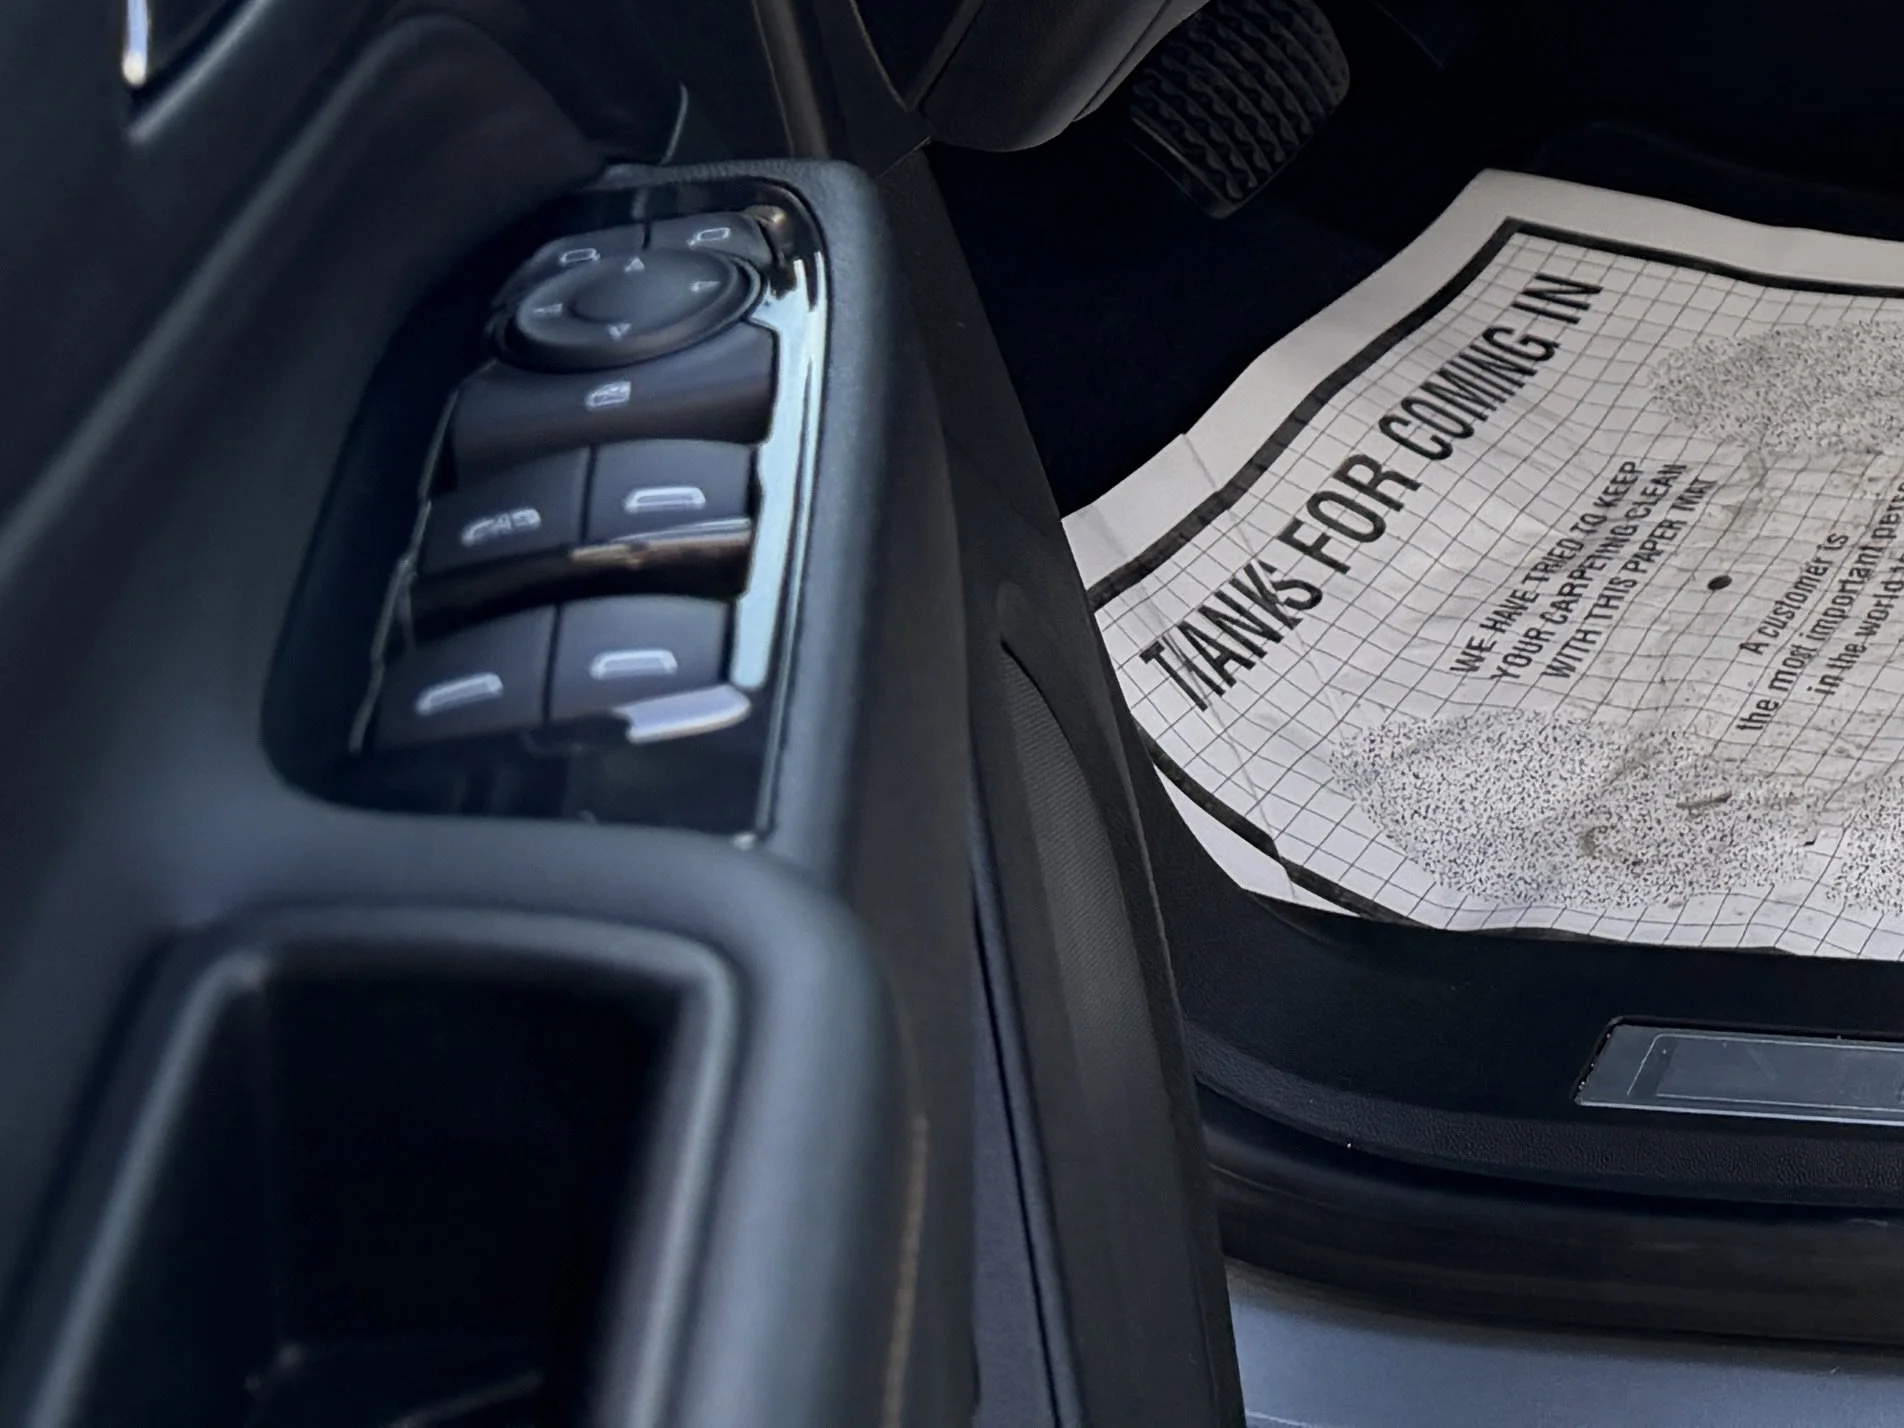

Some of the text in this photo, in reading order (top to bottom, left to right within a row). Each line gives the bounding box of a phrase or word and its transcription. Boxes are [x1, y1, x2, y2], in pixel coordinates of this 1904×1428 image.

[1277, 453, 1422, 574] FOR
[1378, 324, 1562, 461] COMING
[1510, 272, 1603, 325] IN
[1450, 461, 1642, 673] WE HAVE TRIED TO KEEP
[1490, 464, 1687, 679] YOUR CARPETING CLEAN
[1543, 477, 1718, 679] WITH THIS PAPER MAT
[1736, 698, 1779, 731] the
[1768, 643, 1817, 692] most
[1799, 545, 1882, 641] important
[1739, 532, 1849, 656] A customer is
[1807, 671, 1843, 695] in
[1829, 641, 1867, 670] the
[1855, 579, 1904, 638] world
